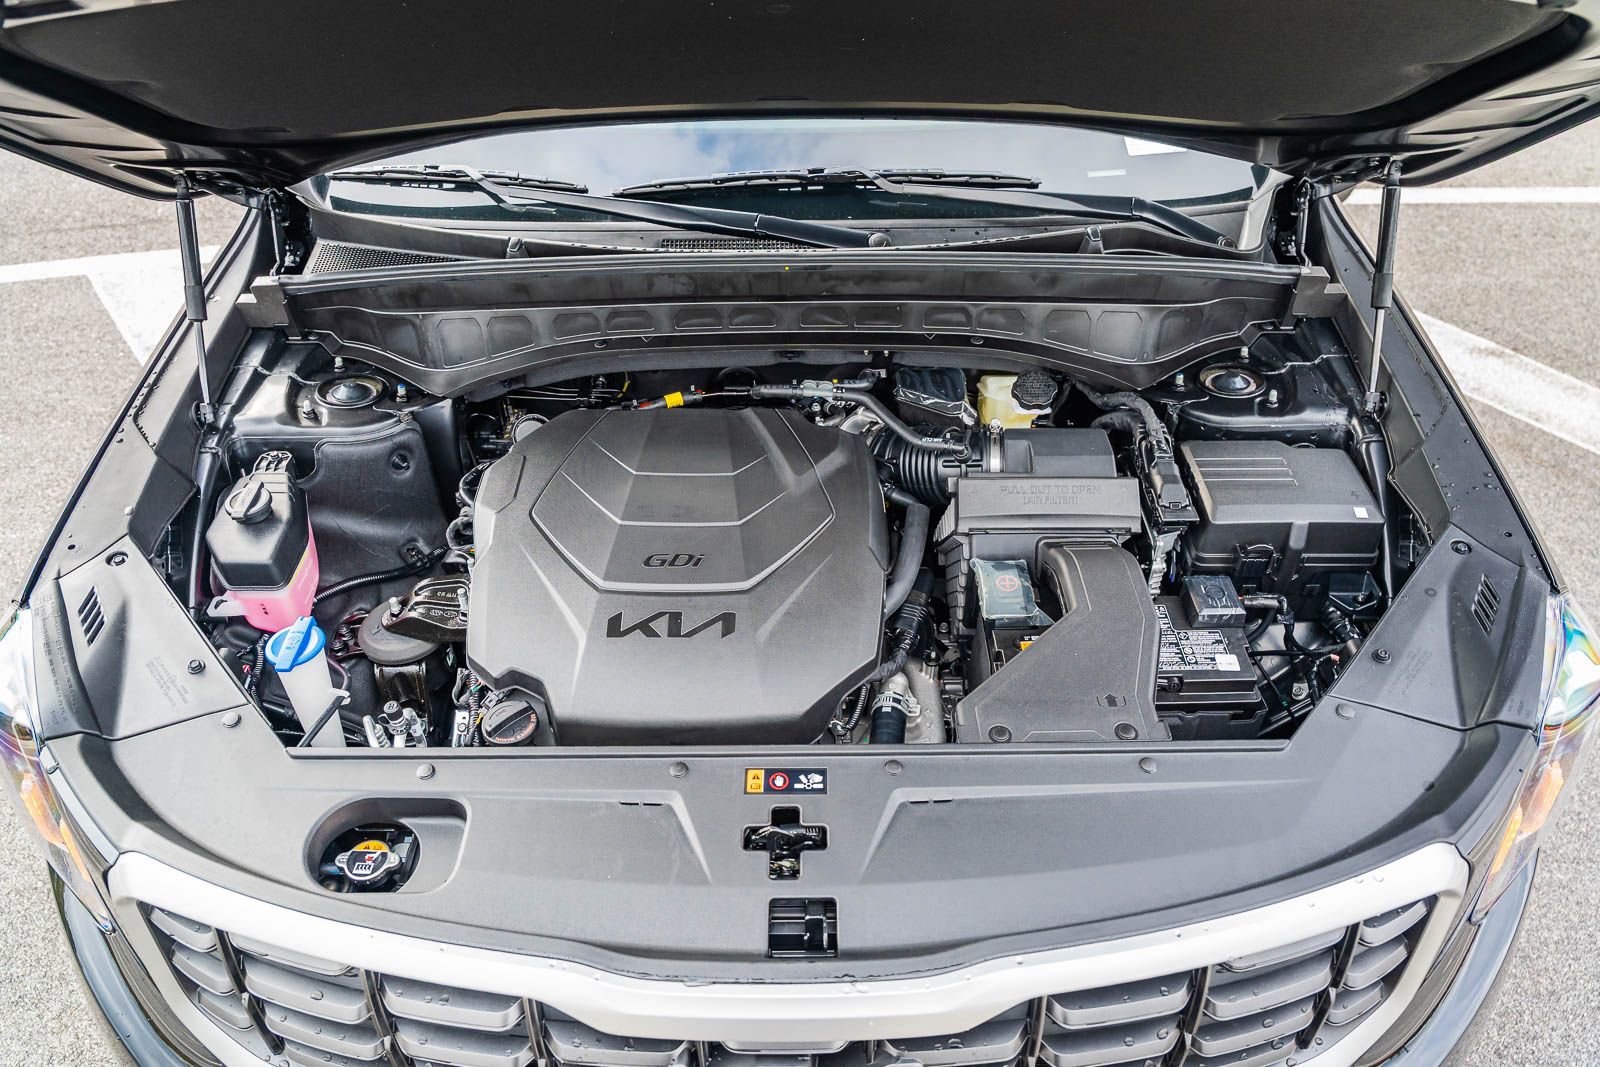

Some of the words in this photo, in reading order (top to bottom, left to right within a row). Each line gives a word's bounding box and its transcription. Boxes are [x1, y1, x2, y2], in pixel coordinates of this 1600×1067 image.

[1000, 485, 1026, 495] PULL
[1031, 485, 1052, 495] OUT
[1054, 485, 1069, 495] TO
[1071, 485, 1101, 495] OPEN
[642, 553, 705, 568] GDi
[606, 610, 737, 639] KIA
